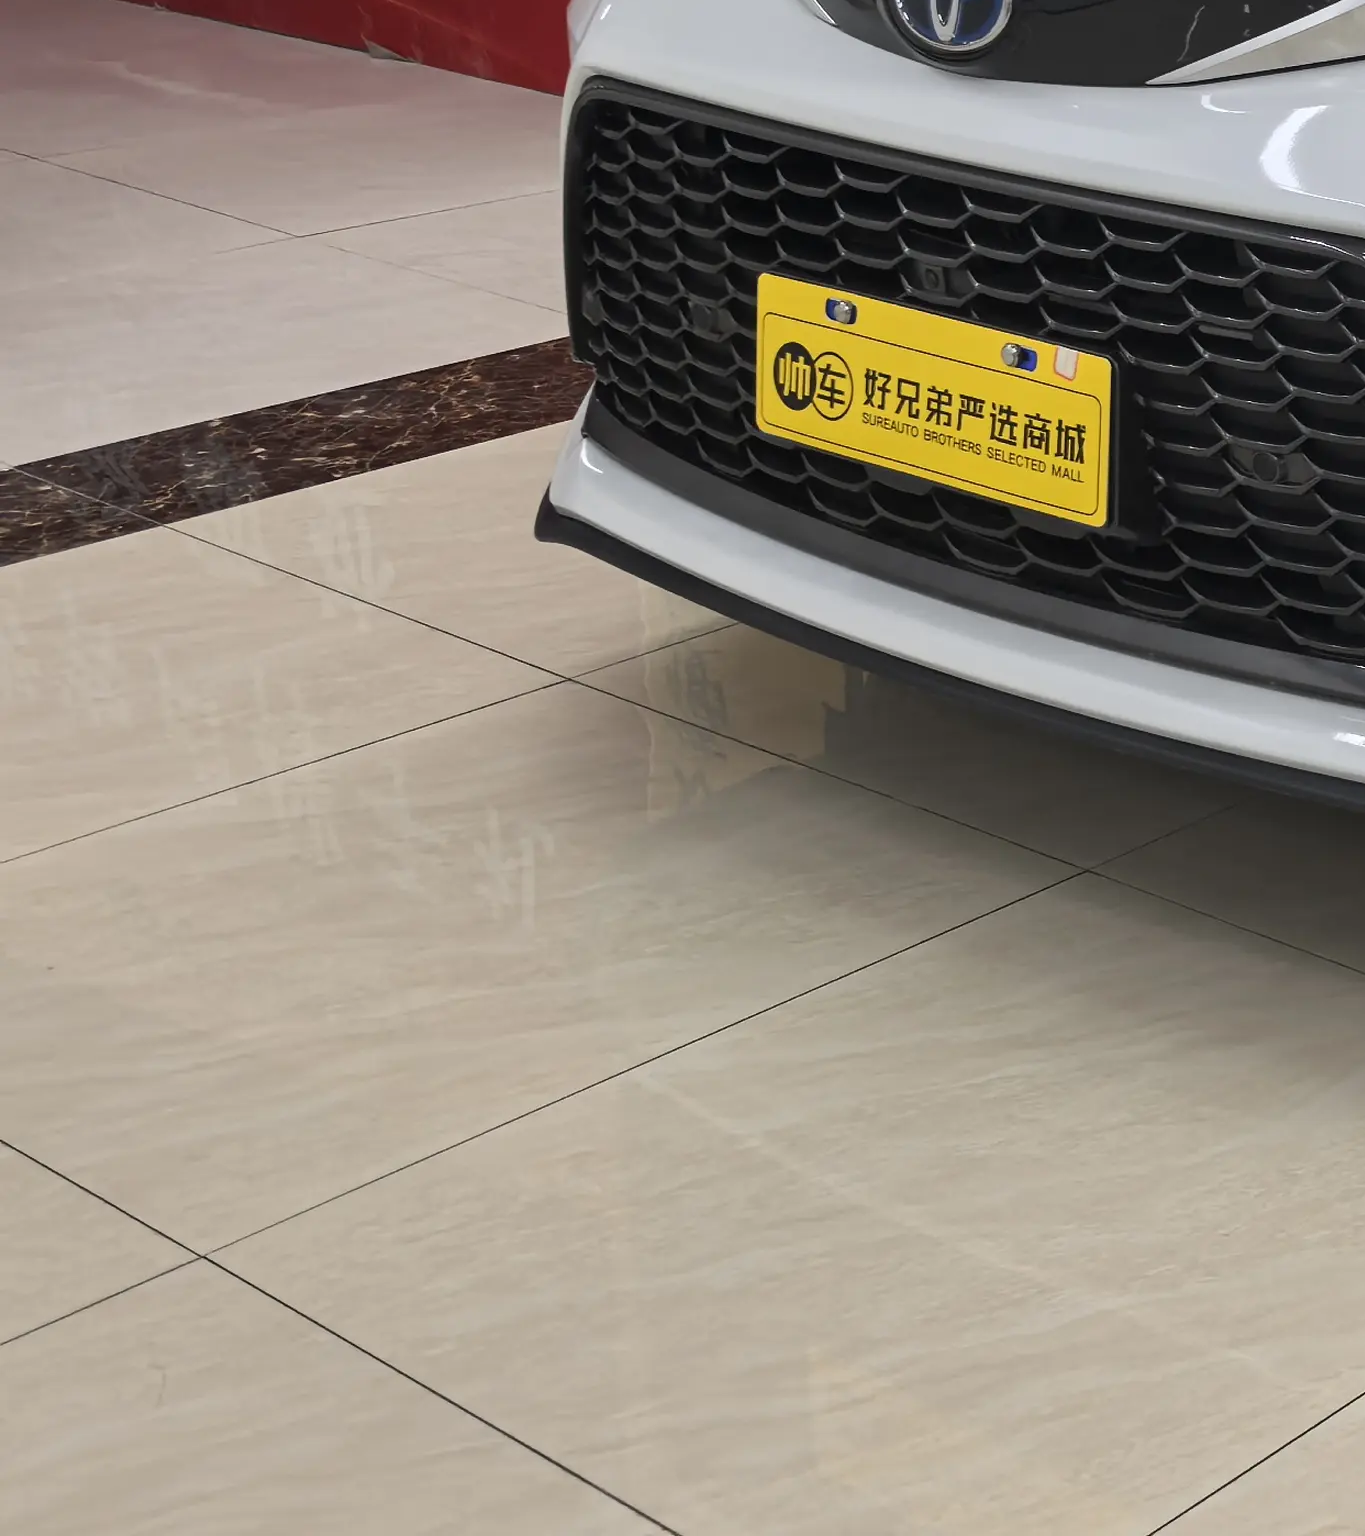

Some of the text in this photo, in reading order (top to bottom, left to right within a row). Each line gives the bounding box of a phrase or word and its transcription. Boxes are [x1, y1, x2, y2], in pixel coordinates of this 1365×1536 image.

[862, 412, 1085, 484] SUREAUTO BROTHERS SELECTED MALL
[863, 367, 1087, 465] 好兄弟严选商城
